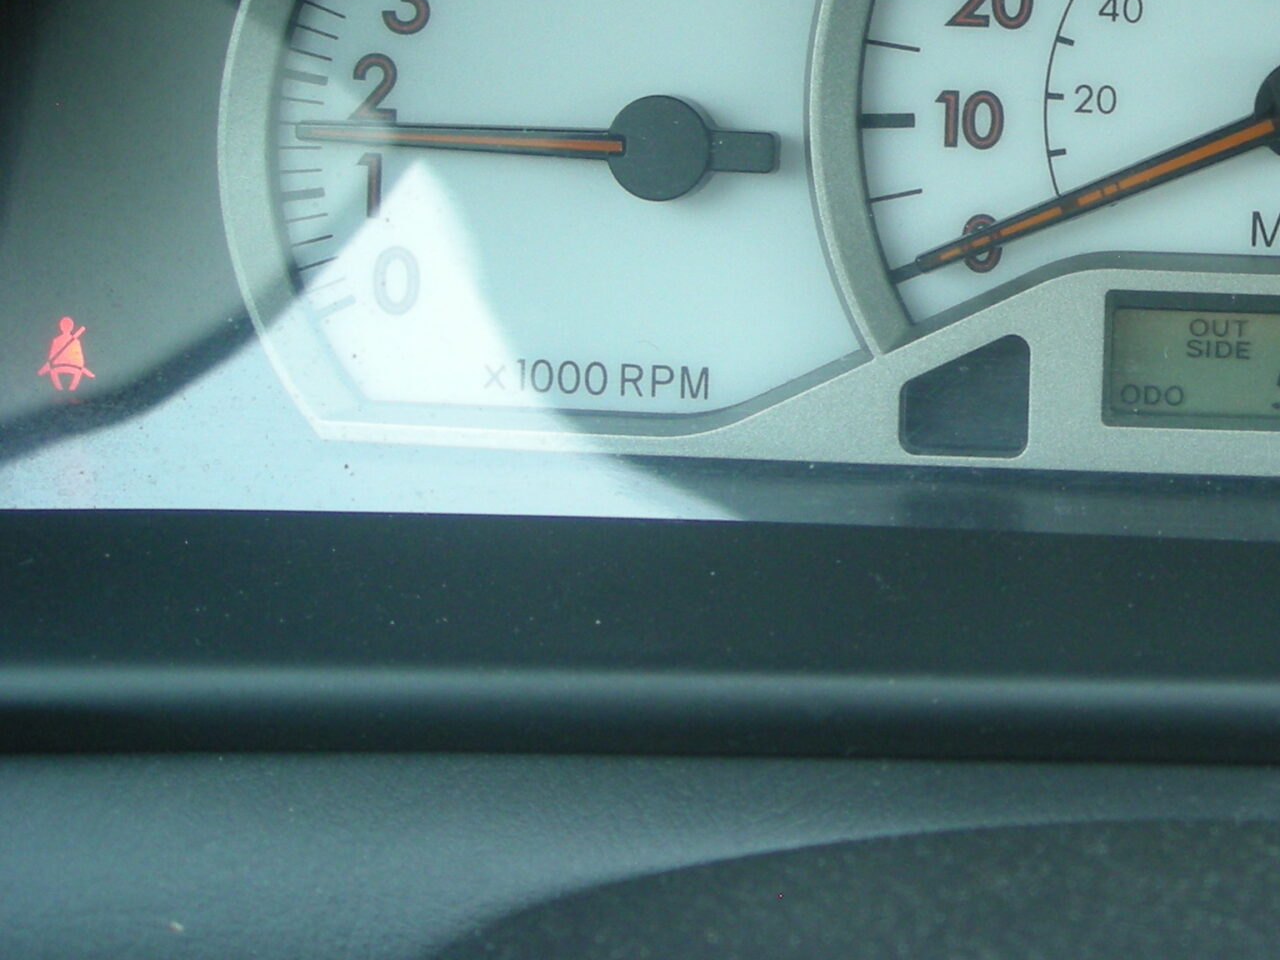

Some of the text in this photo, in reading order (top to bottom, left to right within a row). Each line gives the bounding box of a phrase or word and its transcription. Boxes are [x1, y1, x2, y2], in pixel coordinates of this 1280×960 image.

[348, 53, 398, 122] 2
[1074, 84, 1117, 114] 20
[934, 89, 1005, 150] 10
[357, 153, 382, 219] 1
[372, 245, 420, 316] 0
[1189, 318, 1249, 338] OUT
[1186, 340, 1251, 360] SIDE
[620, 363, 709, 400] RPM
[1120, 384, 1185, 407] ODO
